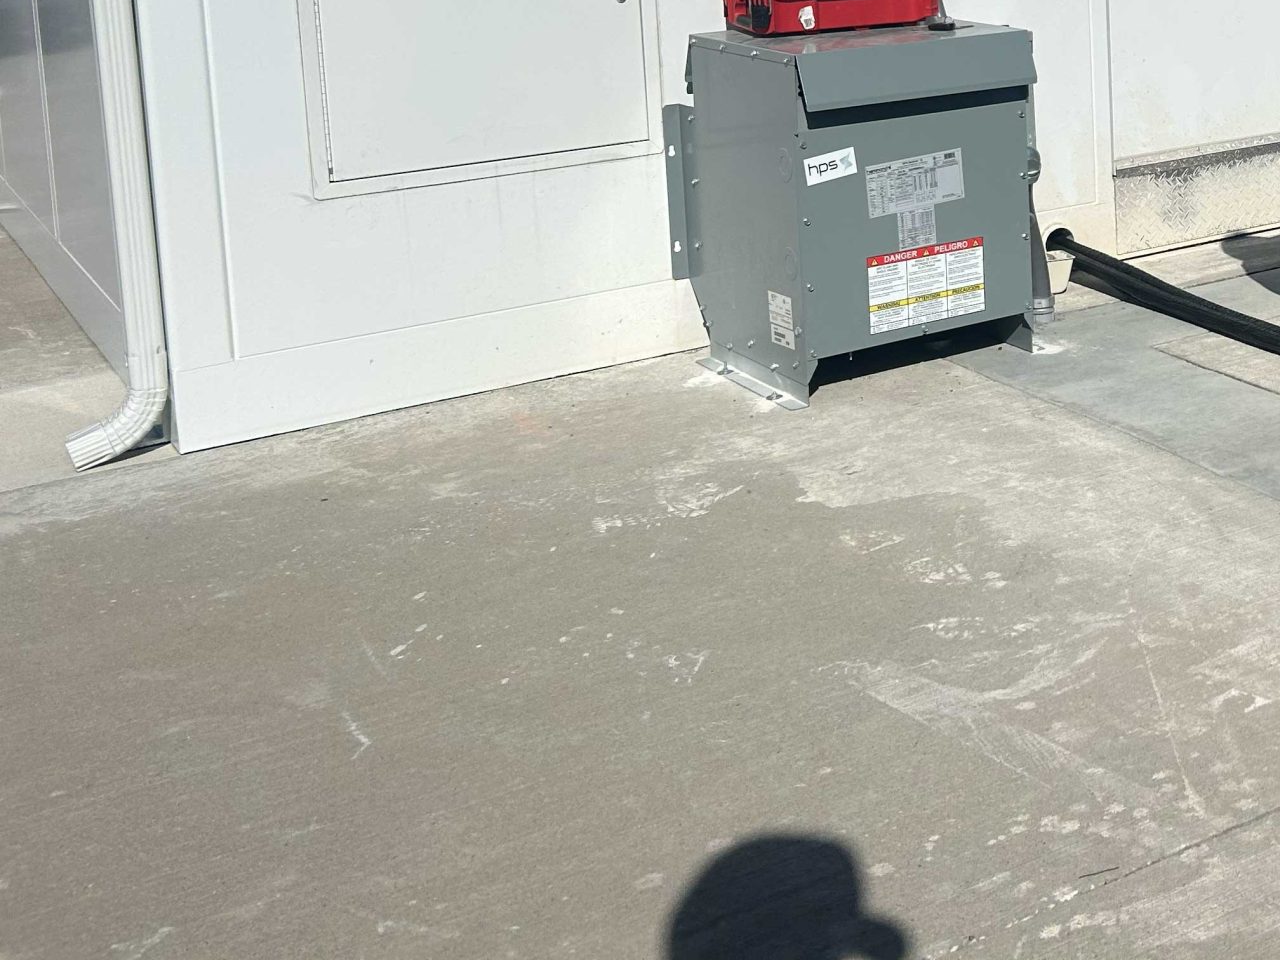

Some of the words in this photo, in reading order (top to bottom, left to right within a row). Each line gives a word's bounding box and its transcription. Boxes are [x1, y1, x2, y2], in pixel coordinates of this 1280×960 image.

[808, 159, 838, 176] hps
[884, 250, 918, 263] DANGER
[934, 241, 968, 253] PELIGRO
